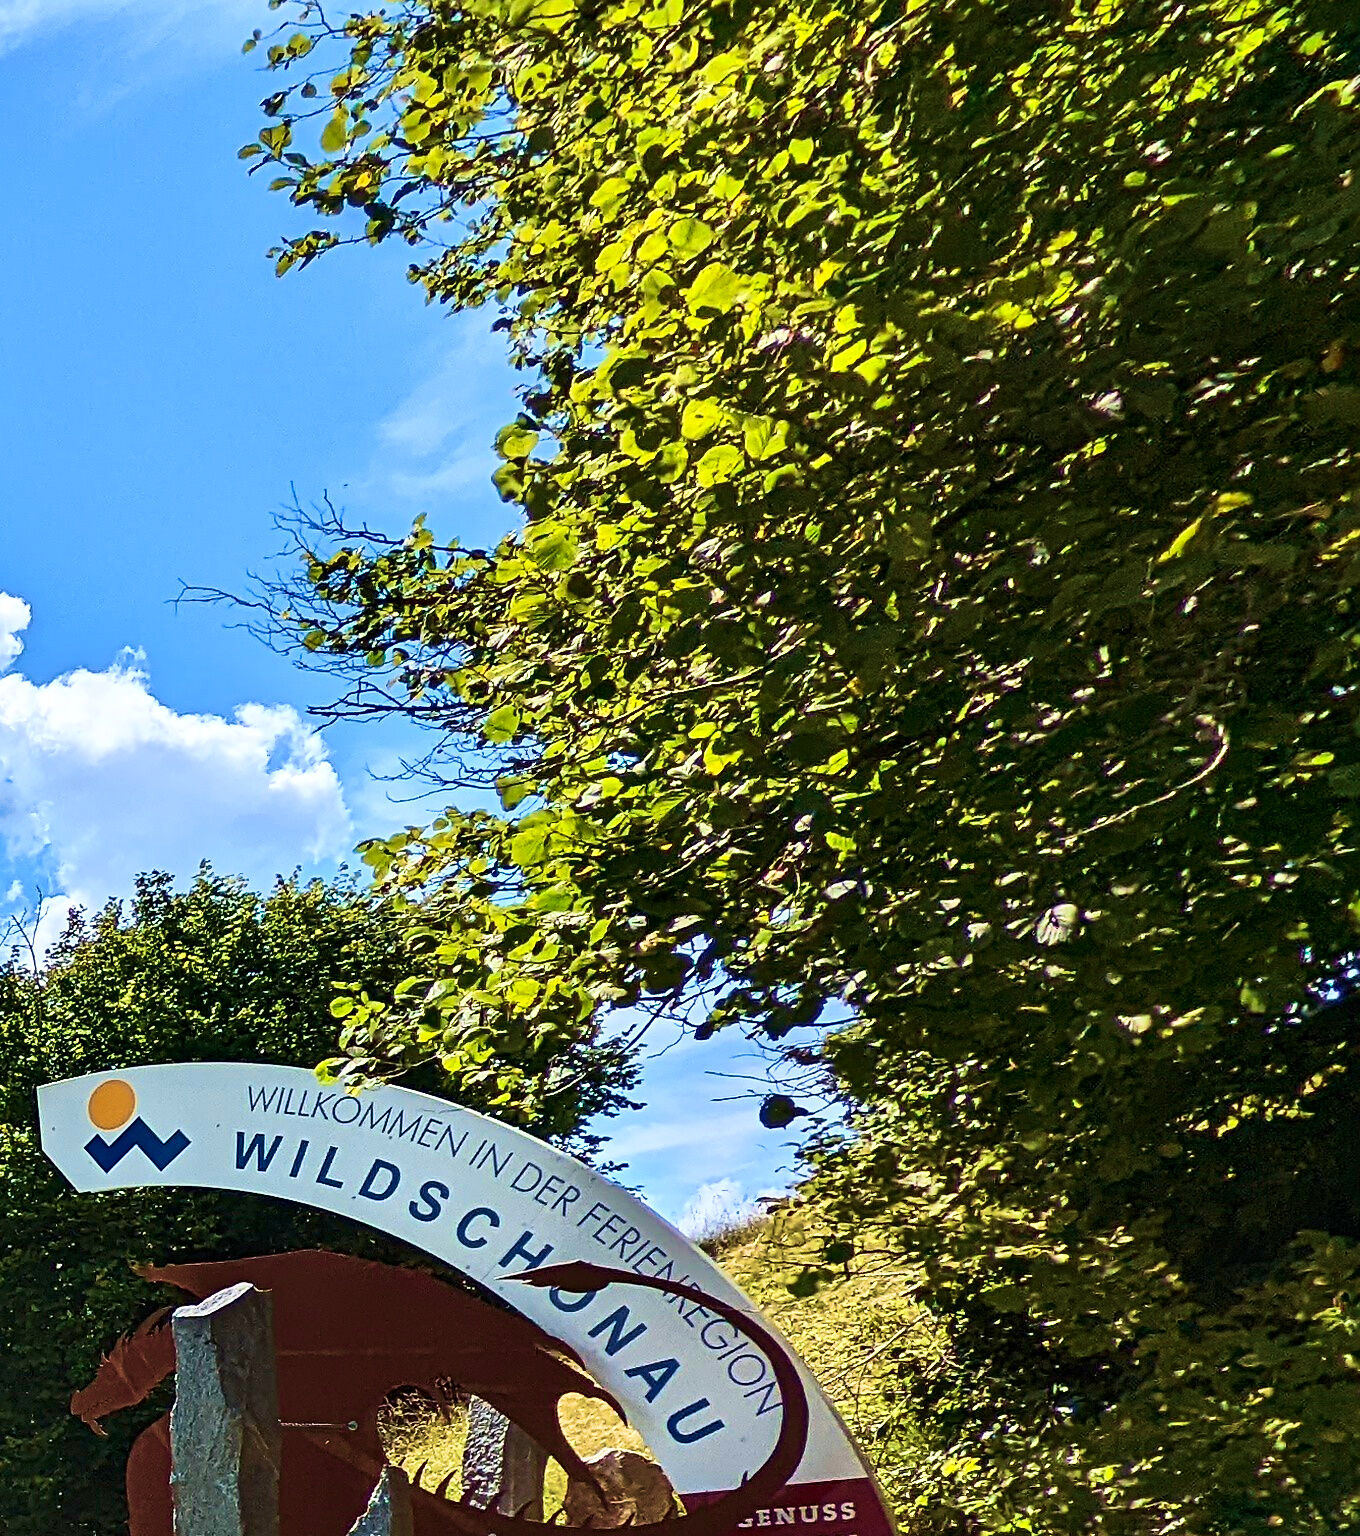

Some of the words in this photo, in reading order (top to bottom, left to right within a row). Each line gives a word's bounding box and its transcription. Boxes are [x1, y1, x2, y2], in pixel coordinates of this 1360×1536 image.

[248, 1085, 469, 1158] WILLKOMMEN
[468, 1139, 514, 1178] IN
[510, 1161, 581, 1217] DER
